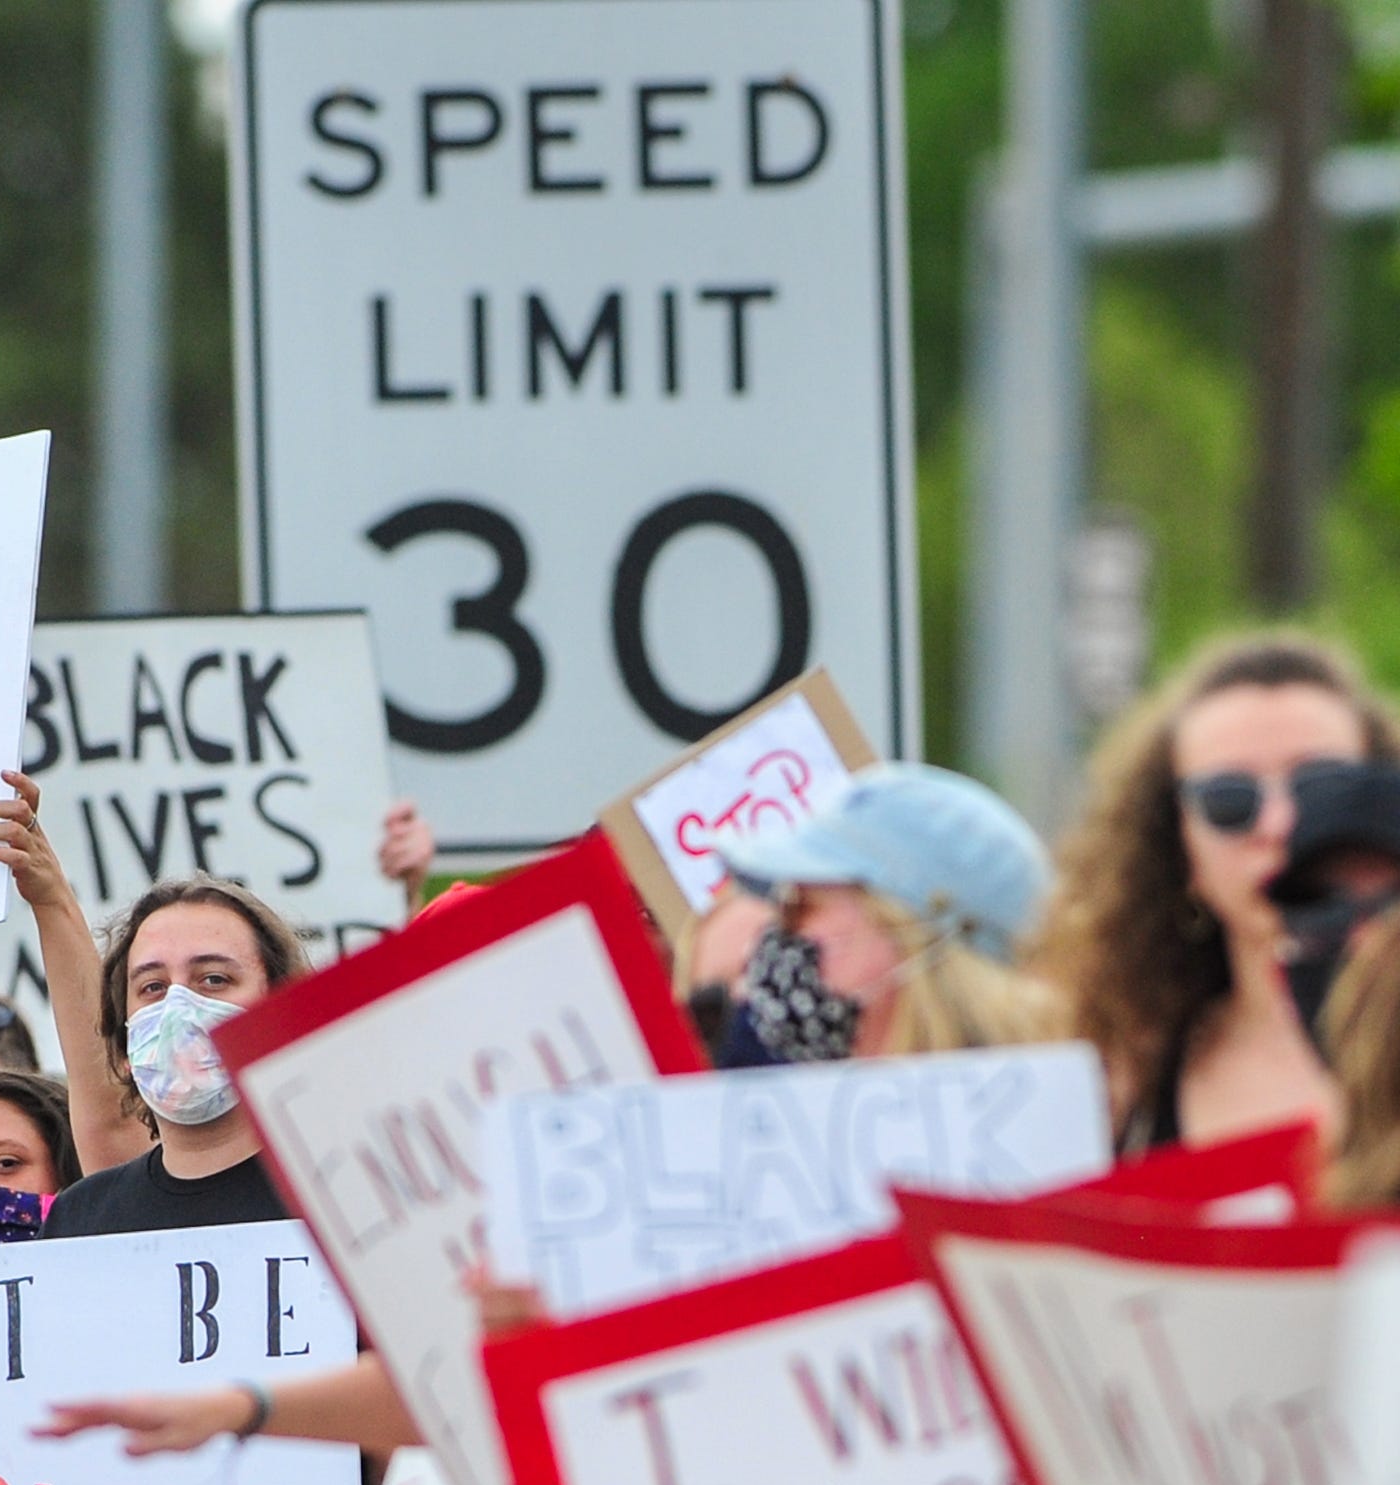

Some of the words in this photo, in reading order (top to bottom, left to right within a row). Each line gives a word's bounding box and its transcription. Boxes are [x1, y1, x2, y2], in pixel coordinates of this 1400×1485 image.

[306, 82, 829, 199] SPEED
[370, 287, 777, 401] LIMIT
[365, 490, 812, 754] 30
[23, 651, 297, 774] BLACK
[72, 774, 321, 900] IVES
[509, 1058, 1040, 1238] BLACK
[175, 1255, 311, 1363] BE
